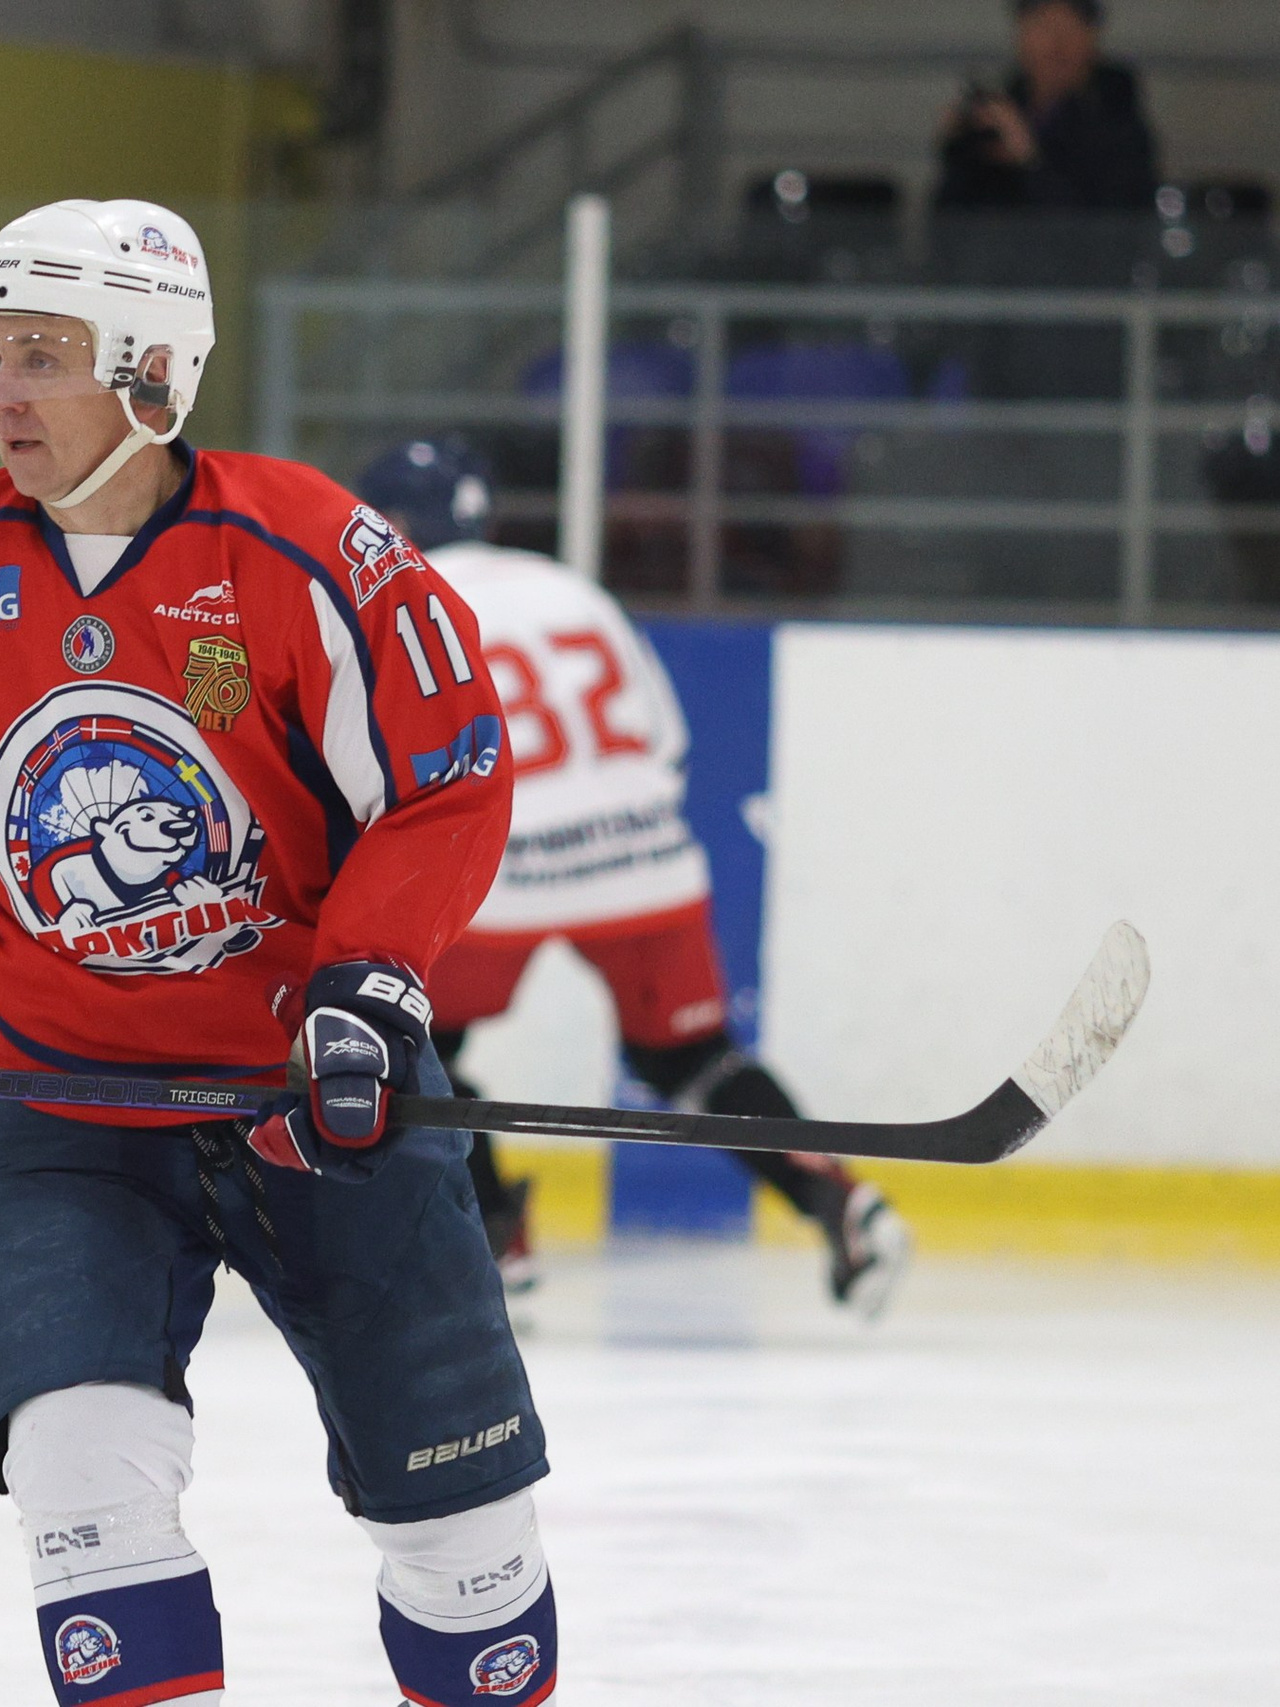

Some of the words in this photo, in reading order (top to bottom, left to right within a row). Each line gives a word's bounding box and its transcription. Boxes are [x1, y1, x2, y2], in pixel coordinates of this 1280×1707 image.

[157, 282, 205, 300] BAUER
[154, 604, 222, 625] ARCTIC
[198, 644, 241, 662] 1941-1945
[396, 593, 474, 698] 11
[183, 655, 250, 723] 76
[356, 971, 434, 1030] BA
[170, 1089, 236, 1106] TRIGGER
[406, 1414, 520, 1472] BAUER
